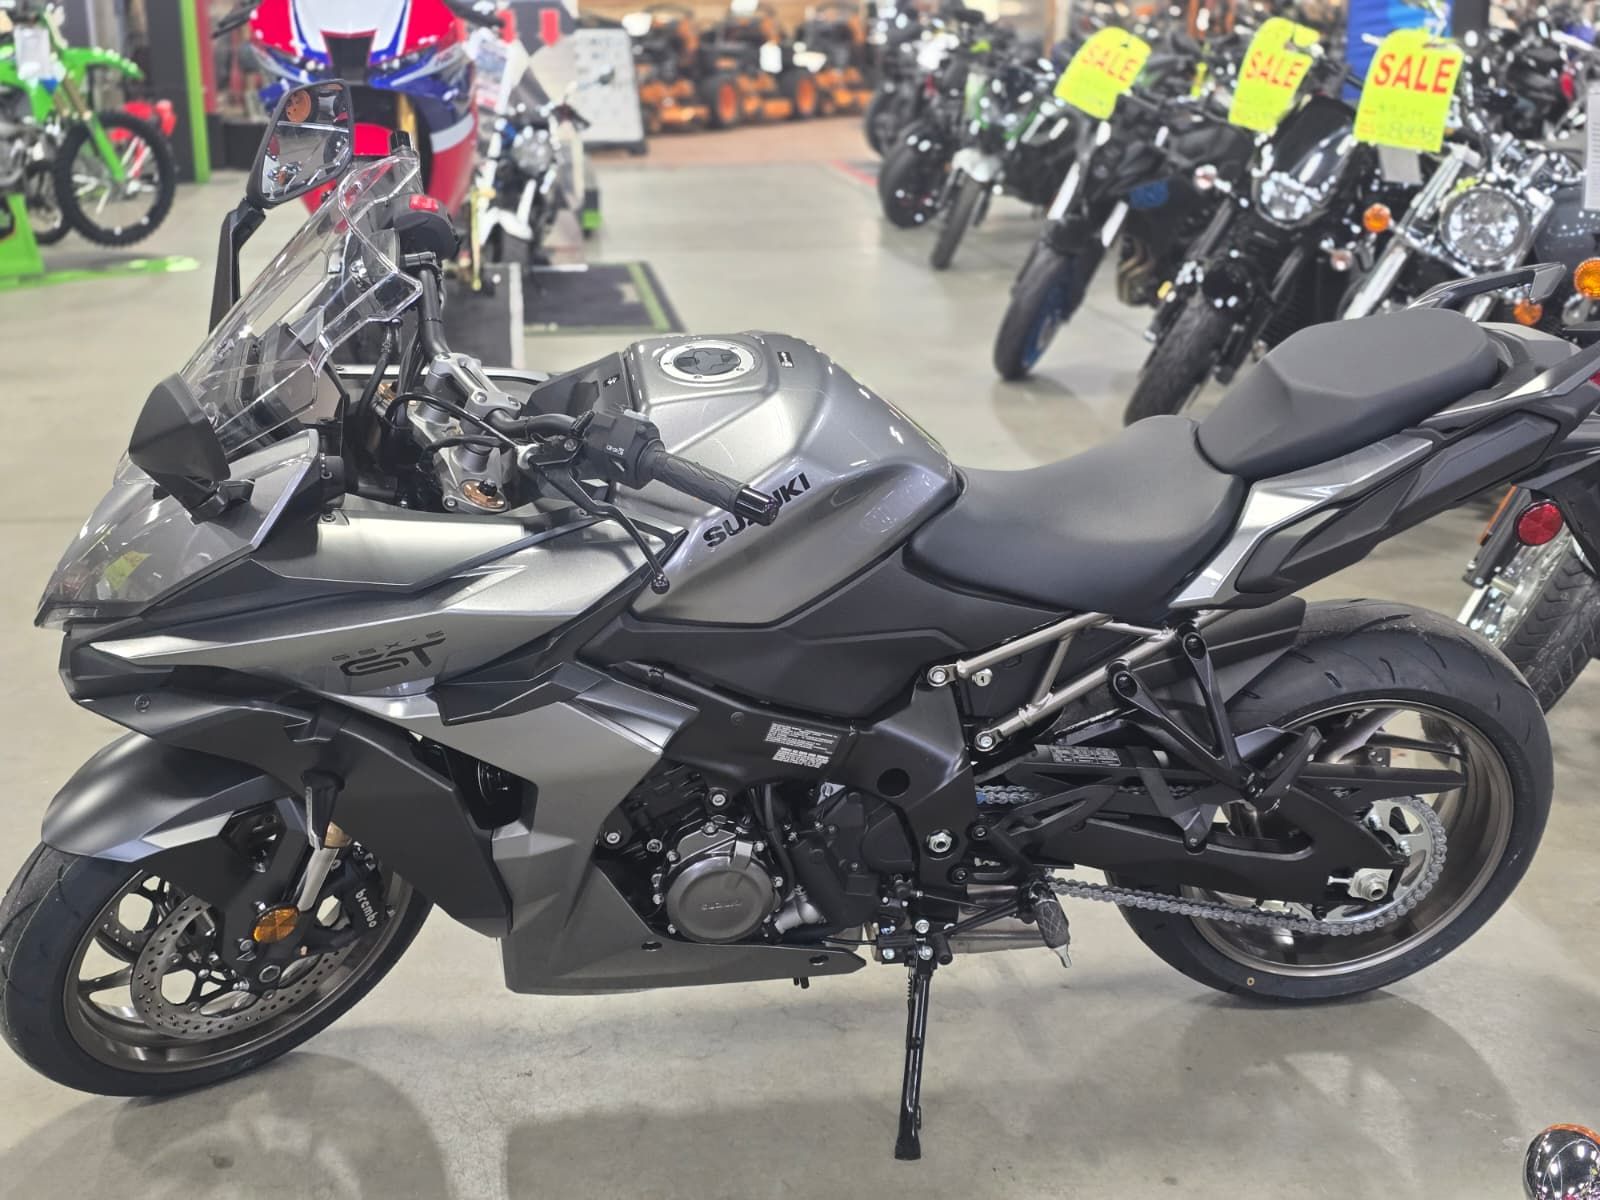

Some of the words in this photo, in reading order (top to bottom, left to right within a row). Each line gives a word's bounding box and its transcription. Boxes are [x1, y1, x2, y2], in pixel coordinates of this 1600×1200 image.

[1081, 43, 1138, 83] SALE
[1245, 49, 1305, 89] SALE
[1374, 52, 1456, 94] SALE
[702, 472, 811, 547] SUKI
[355, 888, 378, 928] brembo
